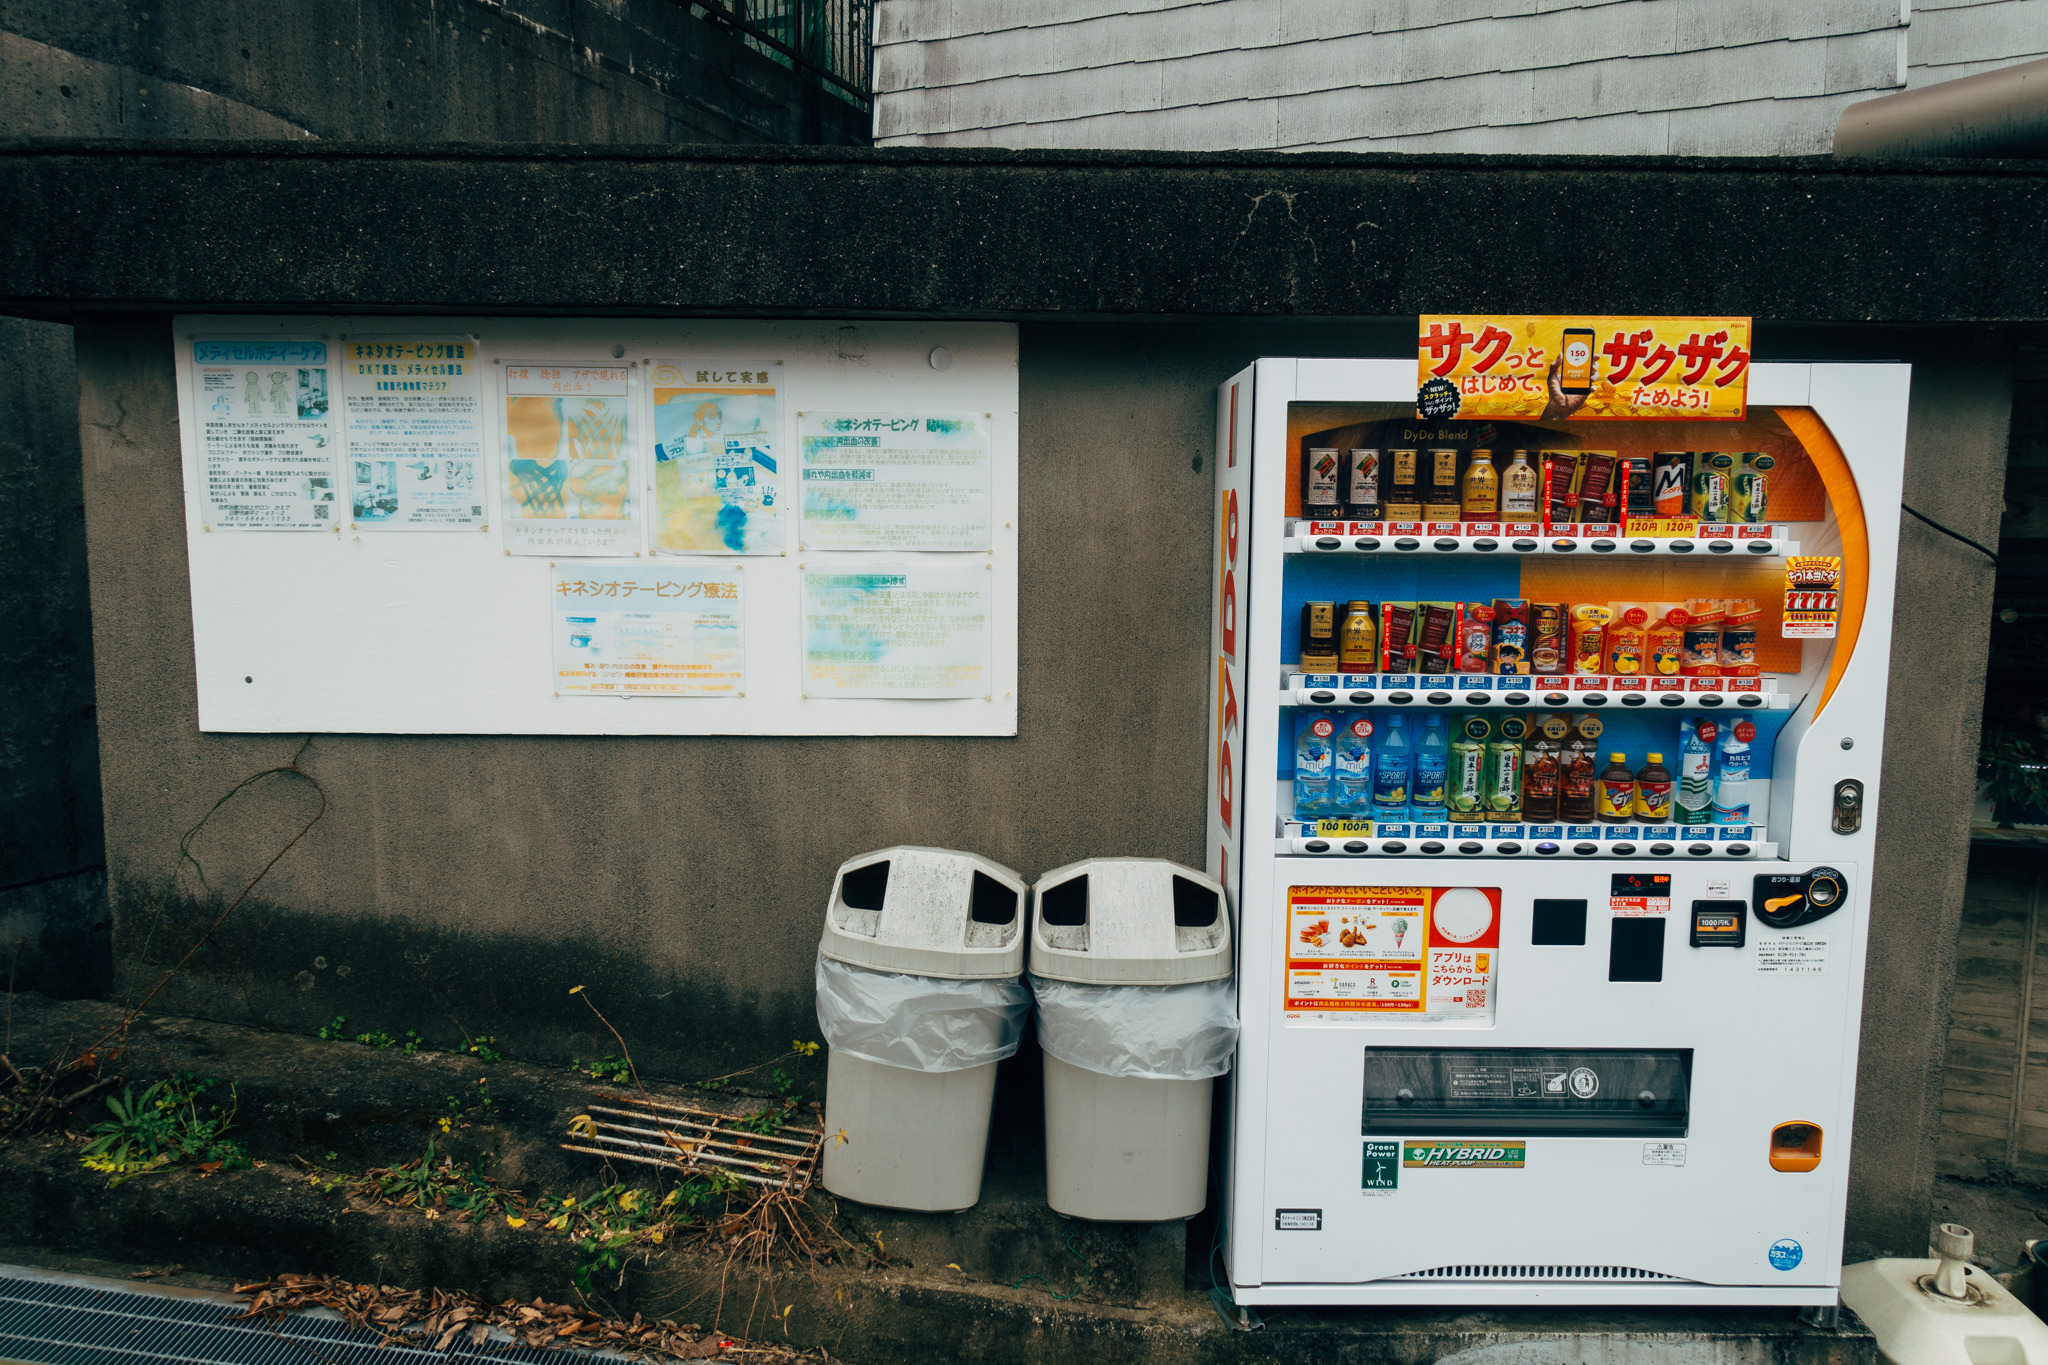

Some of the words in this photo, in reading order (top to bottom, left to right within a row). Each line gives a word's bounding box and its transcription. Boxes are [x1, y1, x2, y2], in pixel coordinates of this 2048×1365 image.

[199, 345, 322, 361] メディセルボディーケア
[1419, 322, 1544, 378] サクっと
[1602, 329, 1750, 388] ザクザク
[696, 370, 768, 384] 試して実感
[1461, 373, 1543, 395] はじめて、
[1404, 430, 1434, 443] DyDo
[1438, 430, 1468, 440] Blend
[1655, 468, 1684, 497] M
[1630, 523, 1658, 531] 120円
[1666, 523, 1693, 531] 120円
[556, 580, 738, 600] キネシオテーピング療法
[1219, 485, 1239, 833] DyDo
[1321, 823, 1338, 831] 100
[1342, 823, 1369, 831] 100円
[1433, 952, 1472, 963] アプリは
[1433, 965, 1472, 974] こちらから
[1432, 975, 1490, 986] ダウンロード
[1425, 1148, 1506, 1162] HYBRID
